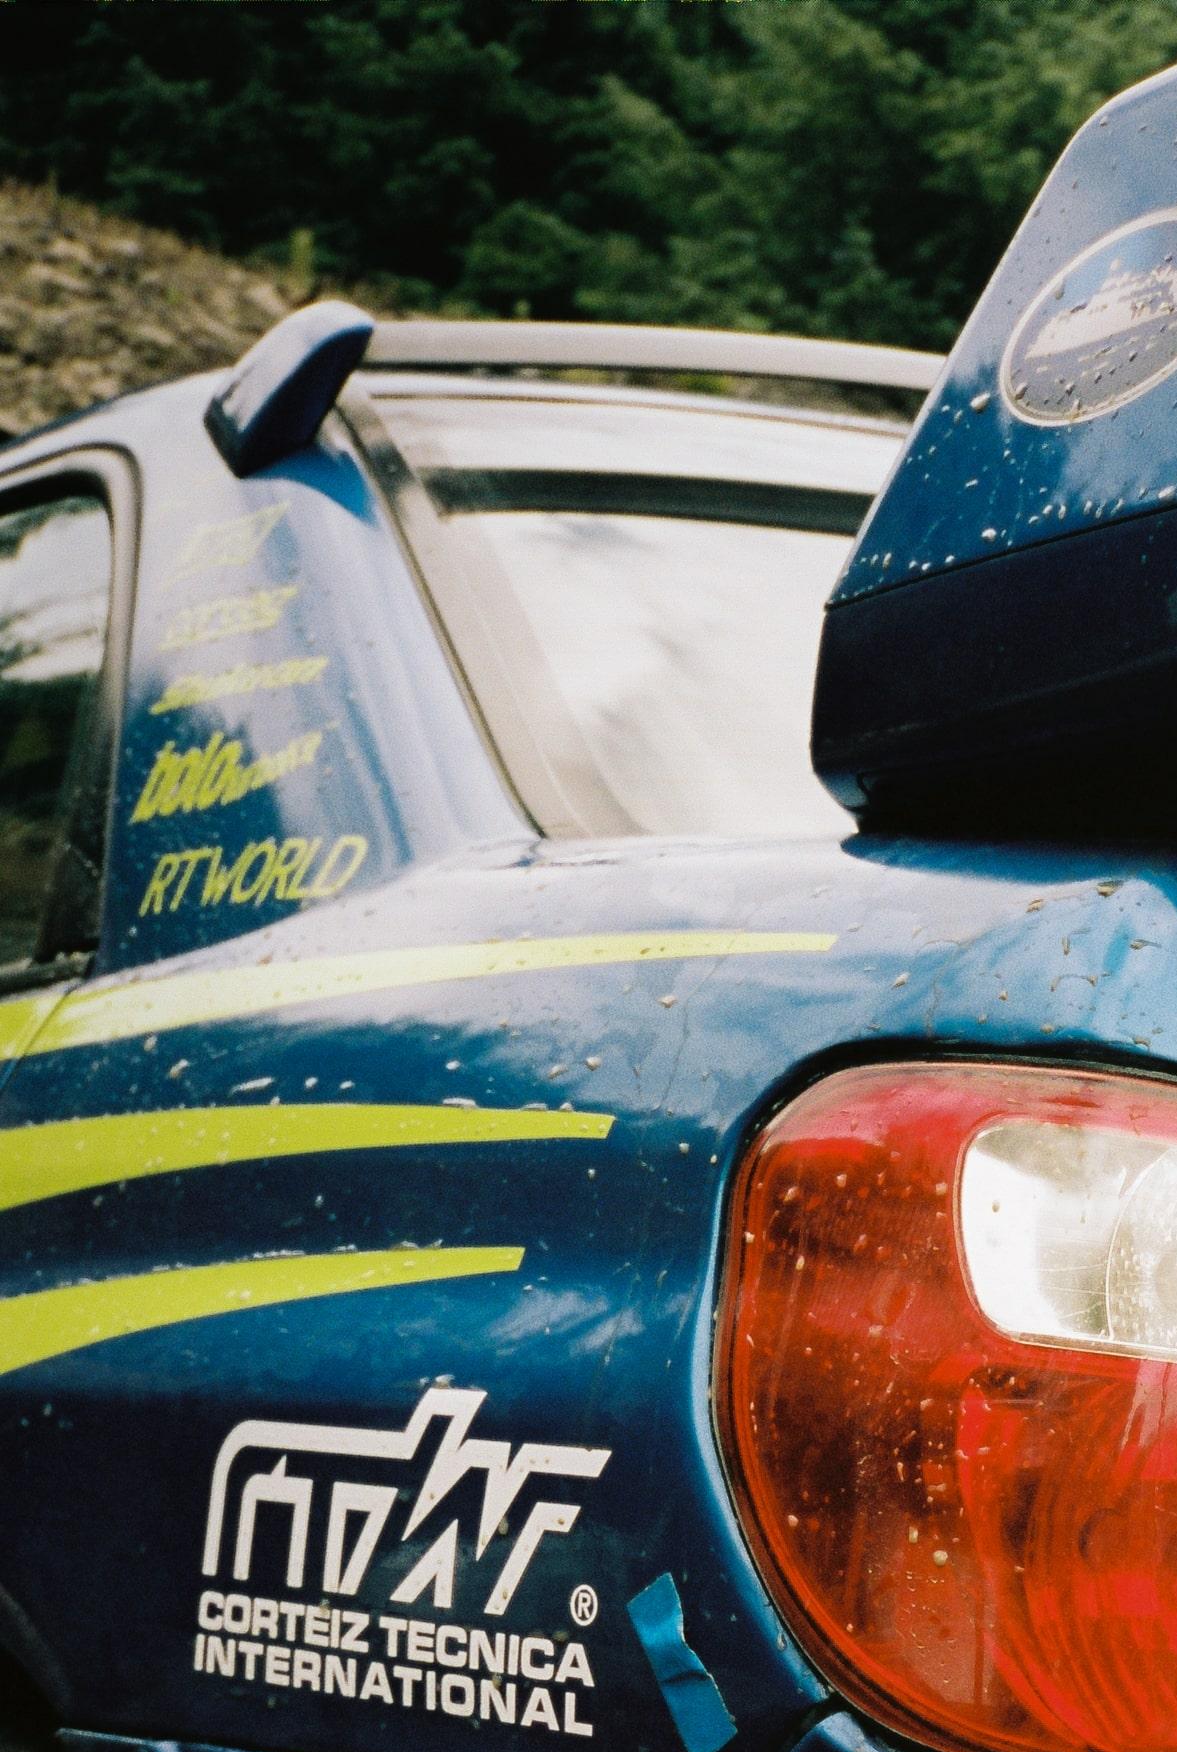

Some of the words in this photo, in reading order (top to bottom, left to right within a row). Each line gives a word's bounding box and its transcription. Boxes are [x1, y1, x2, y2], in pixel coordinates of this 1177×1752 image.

[193, 1633, 594, 1737] INTERNATIONAL
[197, 1590, 370, 1654] CORTEIZ
[379, 1616, 595, 1687] TECNICA
